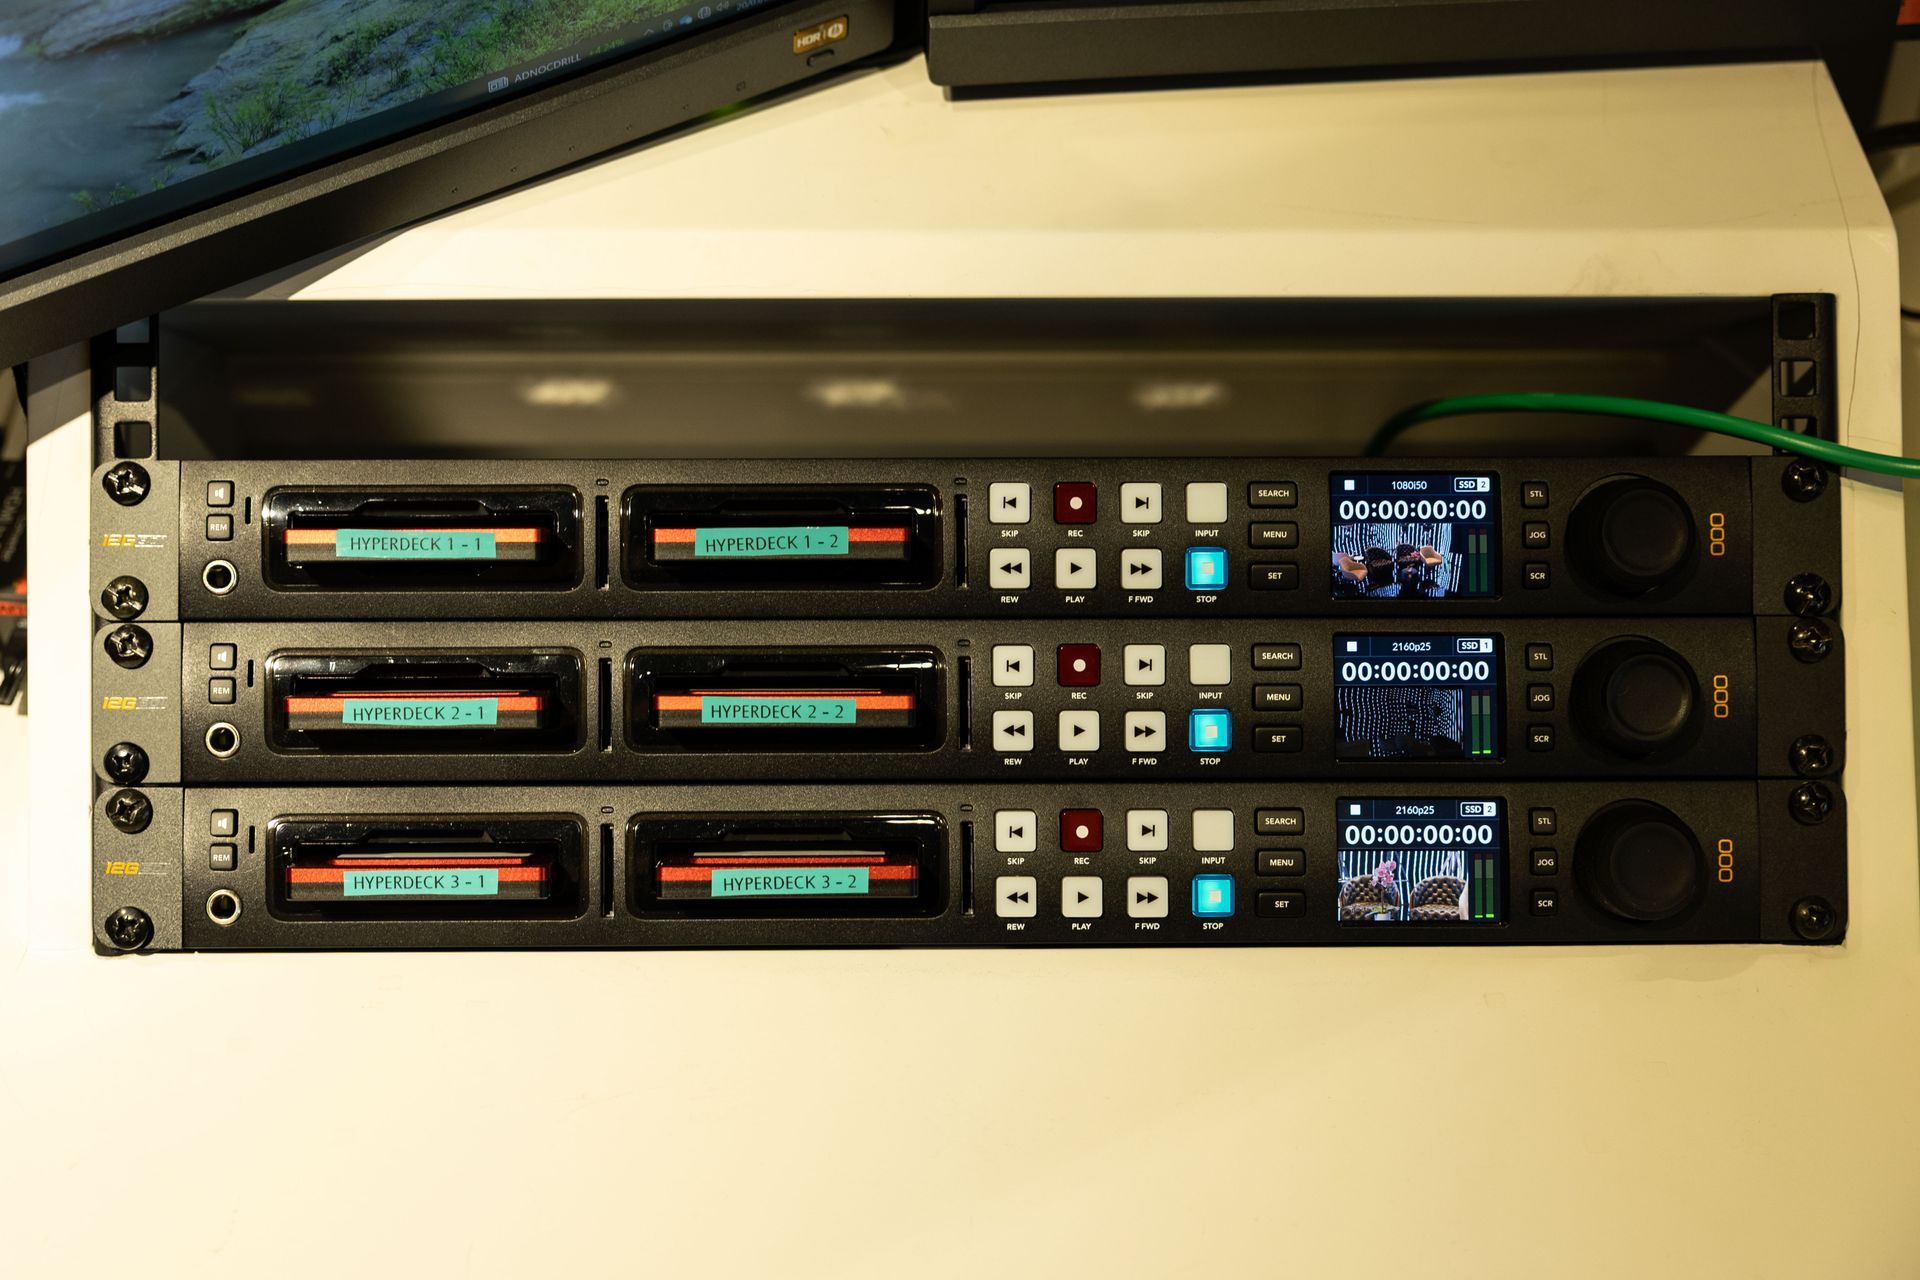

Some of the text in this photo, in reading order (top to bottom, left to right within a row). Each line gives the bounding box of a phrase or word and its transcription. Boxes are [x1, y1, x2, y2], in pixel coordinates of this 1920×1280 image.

[514, 53, 581, 83] ADNOCDRILL
[1391, 480, 1428, 490] 1080i50
[1458, 480, 1487, 489] SSD 2
[1258, 489, 1290, 498] SEARCH
[1529, 490, 1544, 498] STL
[1339, 499, 1487, 520] 00:00:00:00
[210, 523, 228, 531] REM
[1001, 529, 1019, 538] SKIP
[1067, 529, 1084, 538] REC
[1132, 529, 1151, 537] SKIP
[1195, 529, 1219, 537] INPUT
[1263, 530, 1288, 538] MENU
[1529, 531, 1546, 539] JOG
[350, 536, 441, 551] HYPERDECK
[448, 537, 454, 551] 1
[475, 537, 481, 551] 1
[705, 535, 798, 553] HYPERDECK
[804, 535, 810, 549] 1
[829, 534, 838, 548] 2
[1267, 571, 1283, 580] SET
[1530, 572, 1546, 580] SCR
[1000, 595, 1019, 604] REW
[1065, 595, 1085, 603] PLAY
[1196, 595, 1217, 603] STOP
[1392, 641, 1432, 653] 2160p25
[1461, 641, 1489, 650] SSD 1
[1262, 652, 1294, 660] SEARCH
[1533, 652, 1548, 661] STL
[1341, 660, 1490, 682] 00:00:00:00
[212, 686, 230, 695] REM
[1004, 692, 1023, 700] SKIP
[1071, 691, 1087, 700] REC
[1136, 691, 1154, 700] SKIP
[1198, 691, 1223, 700] INPUT
[1266, 693, 1291, 701] MENU
[1533, 694, 1551, 702] JOG
[353, 706, 445, 721] HYPERDECK
[451, 706, 460, 720] 2
[478, 706, 484, 720] 1
[711, 704, 802, 719] HYPERDECK
[807, 704, 817, 719] 2
[835, 704, 844, 719] 2
[1271, 735, 1287, 743] SET
[1534, 735, 1550, 743] SCR
[1004, 758, 1023, 766] REW
[1068, 757, 1089, 766] PLAY
[1199, 757, 1221, 766] STOP
[1395, 805, 1435, 817] 2160p25
[1464, 805, 1493, 814] SSD 2
[1265, 817, 1297, 825] SEARCH
[1537, 817, 1552, 825] STL
[1345, 824, 1493, 845] 00:00:00:00
[212, 854, 230, 862] REM
[1007, 857, 1025, 866] SKIP
[1073, 857, 1090, 865] REC
[1138, 856, 1157, 865] SKIP
[1201, 856, 1226, 865] INPUT
[1269, 858, 1294, 867] MENU
[1537, 858, 1554, 866] JOG
[105, 861, 139, 875] 12G
[354, 875, 445, 890] HYPERDECK
[451, 874, 460, 889] 3
[478, 874, 485, 889] 1
[723, 875, 816, 892] HYPERDECK
[822, 874, 830, 889] 3
[847, 874, 857, 889] 2
[1274, 900, 1290, 908] SET
[1537, 899, 1553, 908] SCR
[1006, 923, 1026, 931] REW
[1071, 922, 1092, 931] PLAY
[1202, 922, 1224, 930] STOP
